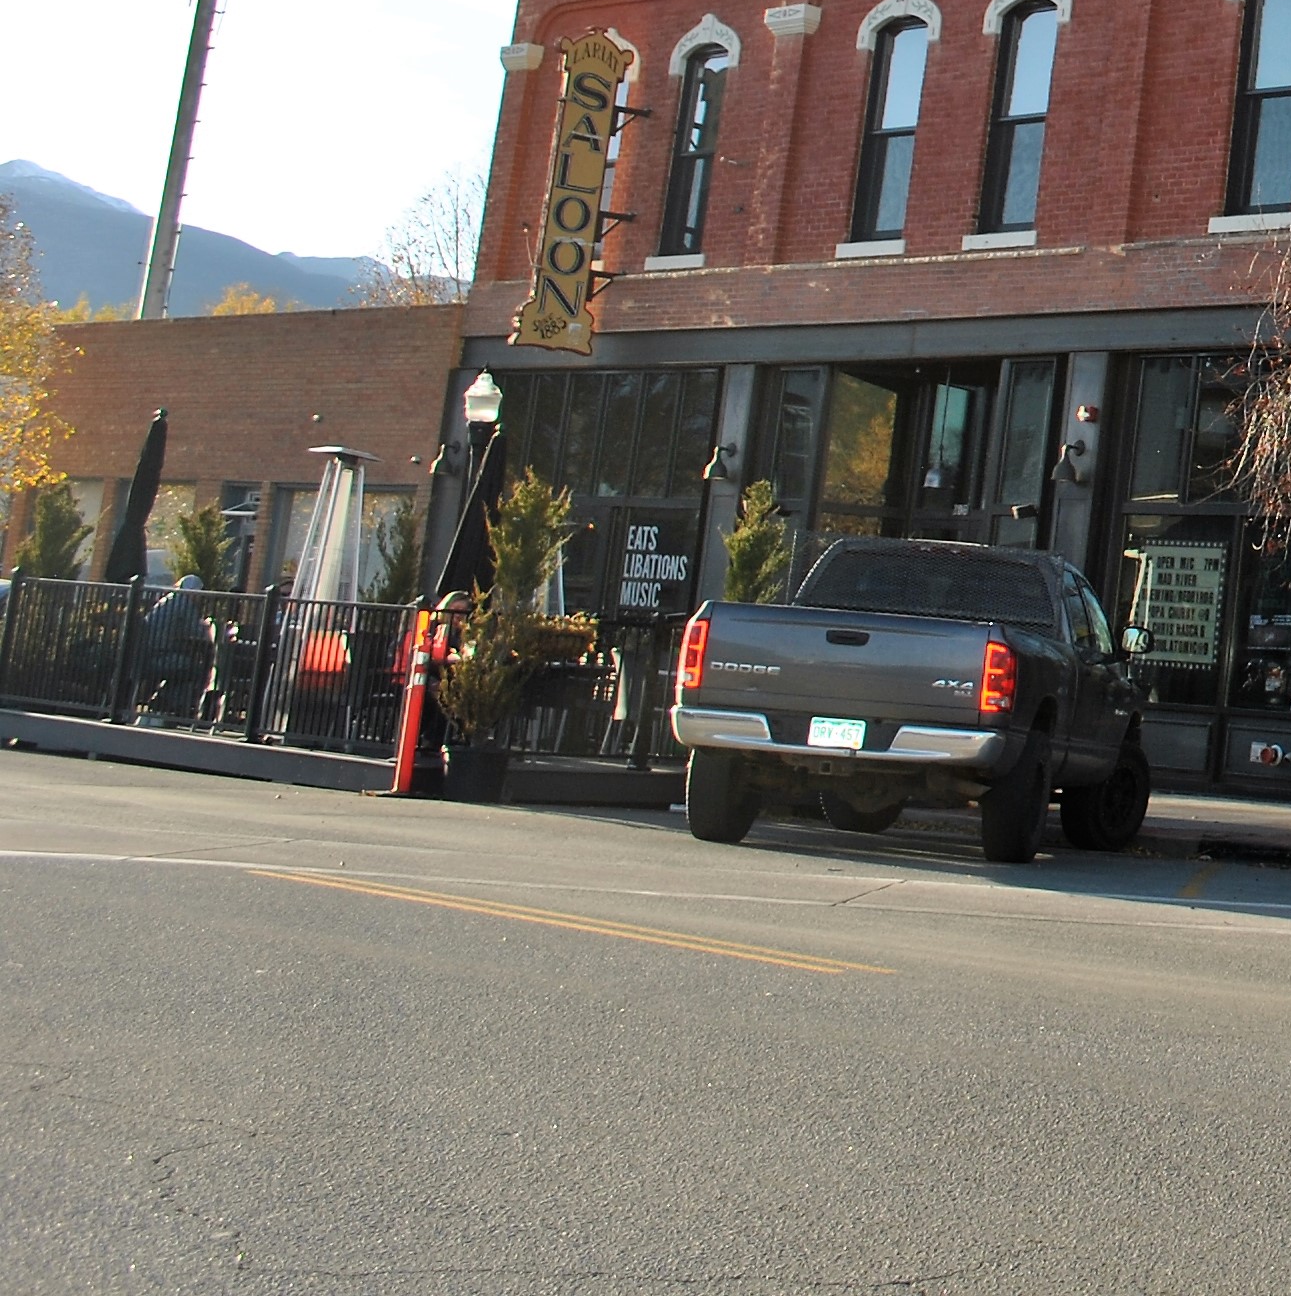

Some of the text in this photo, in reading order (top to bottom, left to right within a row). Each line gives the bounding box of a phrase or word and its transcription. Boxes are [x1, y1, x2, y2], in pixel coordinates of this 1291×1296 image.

[538, 72, 612, 317] SALOON
[540, 316, 567, 339] 1885
[627, 525, 659, 551] EATS
[623, 553, 688, 581] LIBATIONS
[620, 581, 661, 608] MUSIC
[711, 661, 780, 675] DODGE
